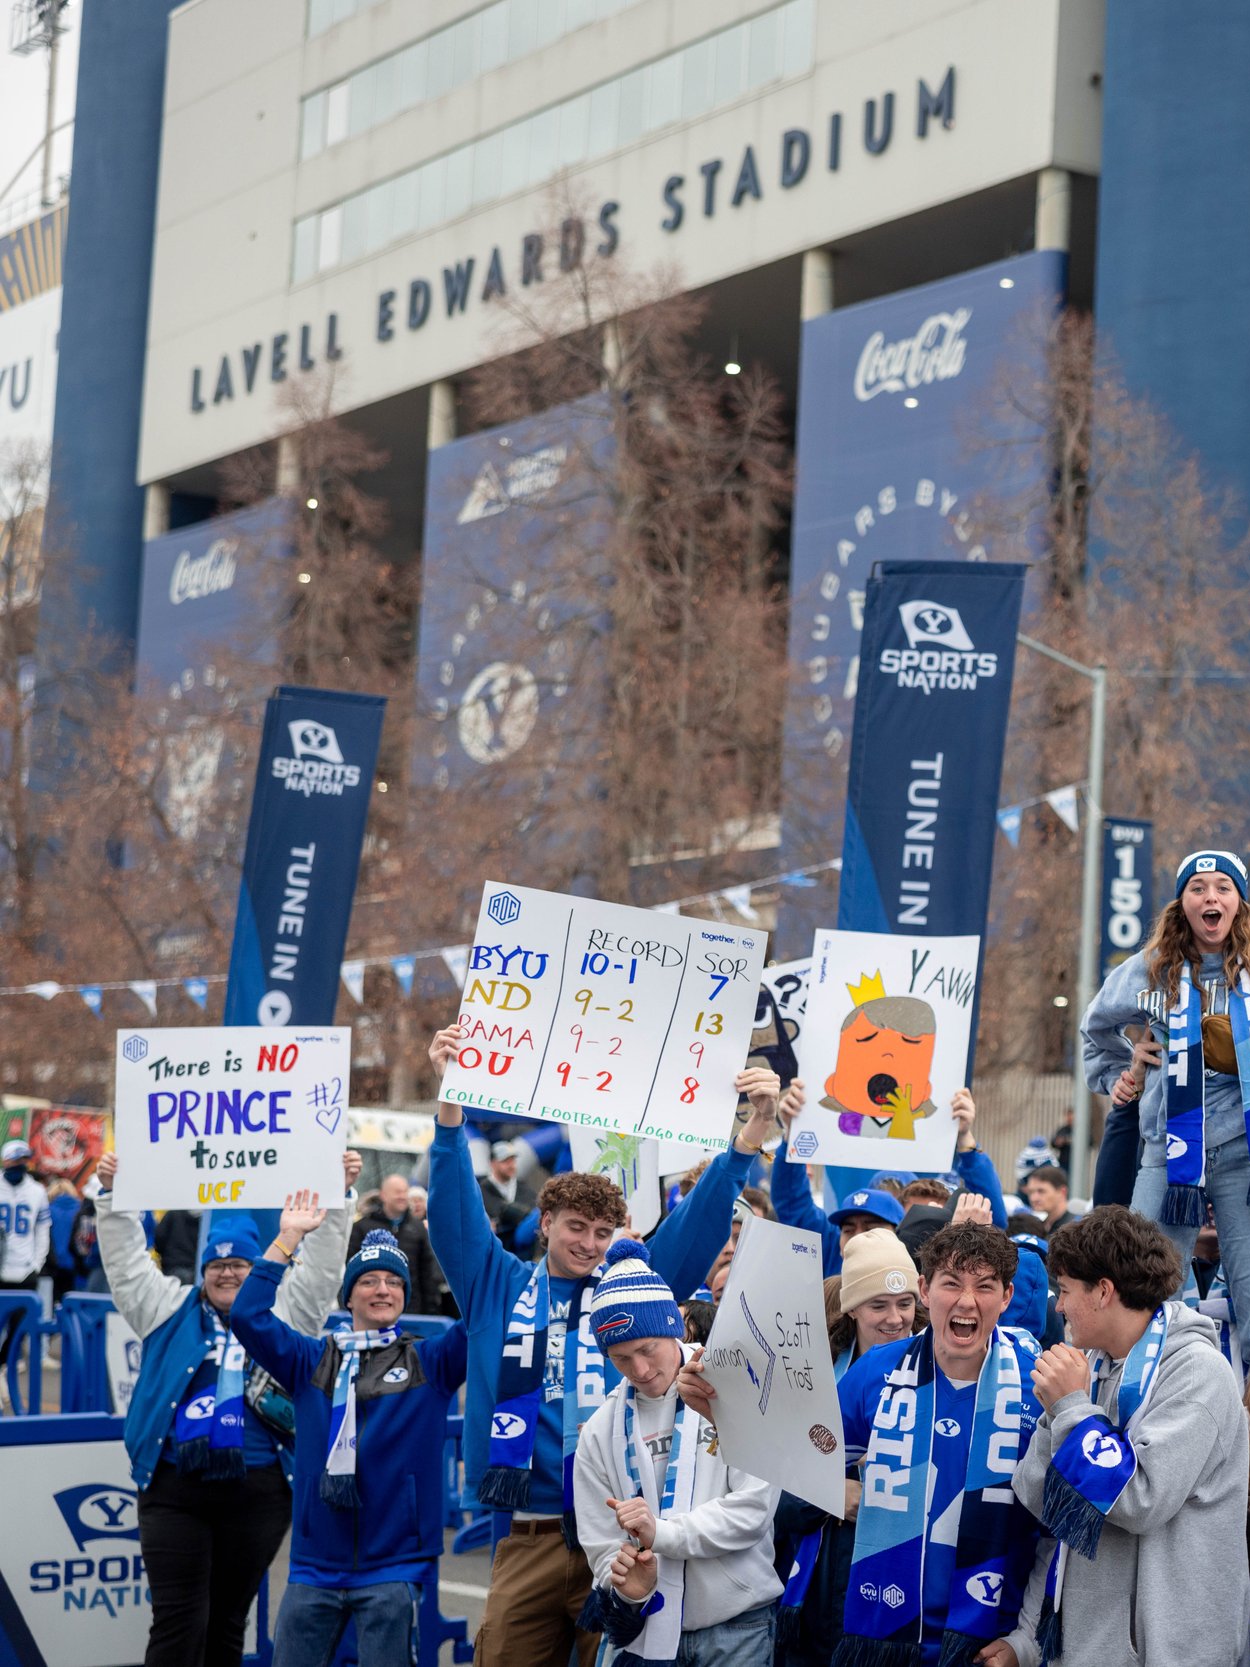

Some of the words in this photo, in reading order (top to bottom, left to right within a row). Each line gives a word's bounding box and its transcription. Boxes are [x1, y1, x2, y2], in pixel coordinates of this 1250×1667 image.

[189, 313, 343, 413] LAVELL
[376, 200, 620, 343] EDWARDS
[661, 65, 956, 233] STADIUM
[879, 649, 998, 678] SPORTS
[898, 671, 978, 696] NATION
[272, 756, 361, 788] SPORTS
[285, 776, 344, 798] NATION
[902, 752, 944, 870] TUNE
[277, 842, 316, 938] TUNE
[897, 880, 931, 926] IN
[269, 942, 300, 982] IN
[588, 929, 684, 968] RECORD
[696, 952, 751, 982] SOR
[701, 931, 736, 945] together.
[469, 944, 549, 980] BYU
[580, 952, 638, 985] 10-1
[708, 974, 729, 1001] 7
[908, 948, 976, 1009] YAWN
[464, 979, 532, 1012] ND
[574, 989, 635, 1023] 9-2
[694, 1011, 724, 1036] 13
[148, 1056, 210, 1082] There
[224, 1050, 242, 1073] is
[256, 1043, 299, 1073] NO
[458, 1014, 535, 1051] BAMA
[569, 1024, 623, 1056] 9-2
[689, 1041, 705, 1069] 9
[458, 1047, 515, 1076] OU
[556, 1062, 614, 1093] 9-2
[679, 1077, 701, 1104] 8
[148, 1088, 292, 1143] PRINCE
[305, 1077, 343, 1107] #2
[445, 1088, 527, 1114] COLLEGE
[540, 1106, 622, 1130] FOOTBALL
[633, 1123, 674, 1139] LOGO
[190, 1140, 218, 1169] to
[225, 1148, 278, 1169] save
[198, 1180, 246, 1204] UCF
[776, 1312, 811, 1349] Scott
[782, 1355, 814, 1391] Frost
[864, 1353, 920, 1512] RISE
